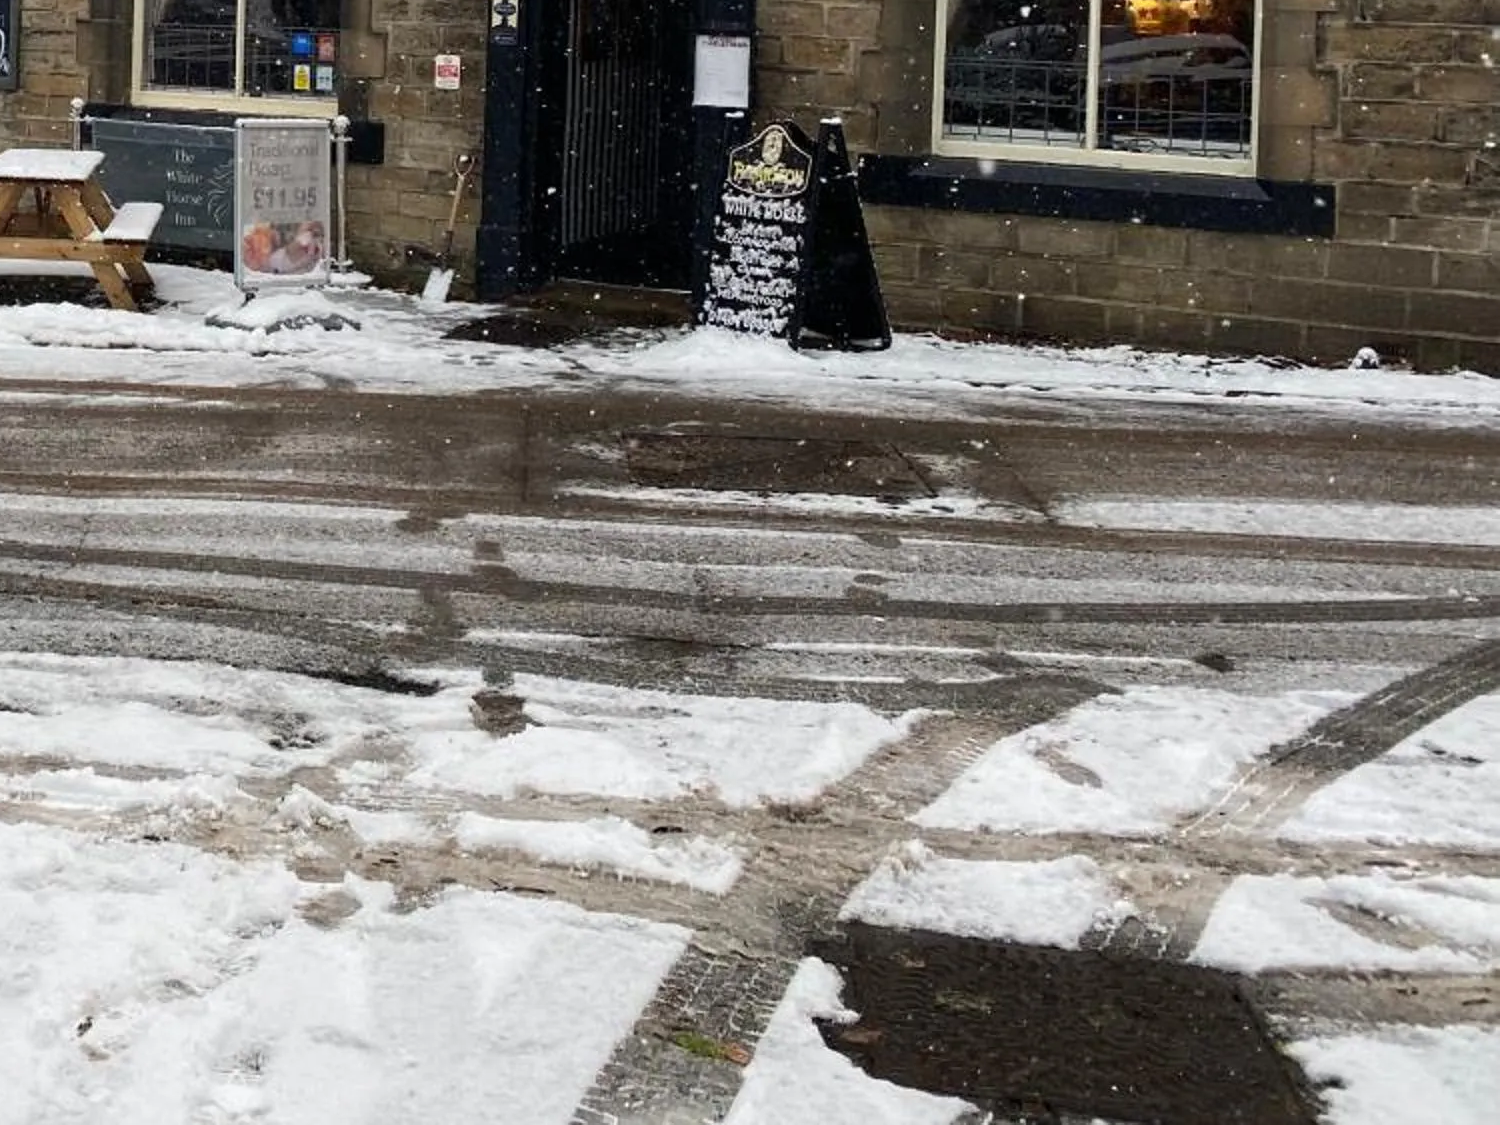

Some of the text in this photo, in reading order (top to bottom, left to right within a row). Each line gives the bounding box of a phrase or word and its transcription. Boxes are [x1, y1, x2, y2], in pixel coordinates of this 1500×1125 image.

[174, 149, 196, 163] The
[166, 170, 203, 184] White
[166, 190, 203, 204] Horse
[175, 212, 197, 226] Inn
